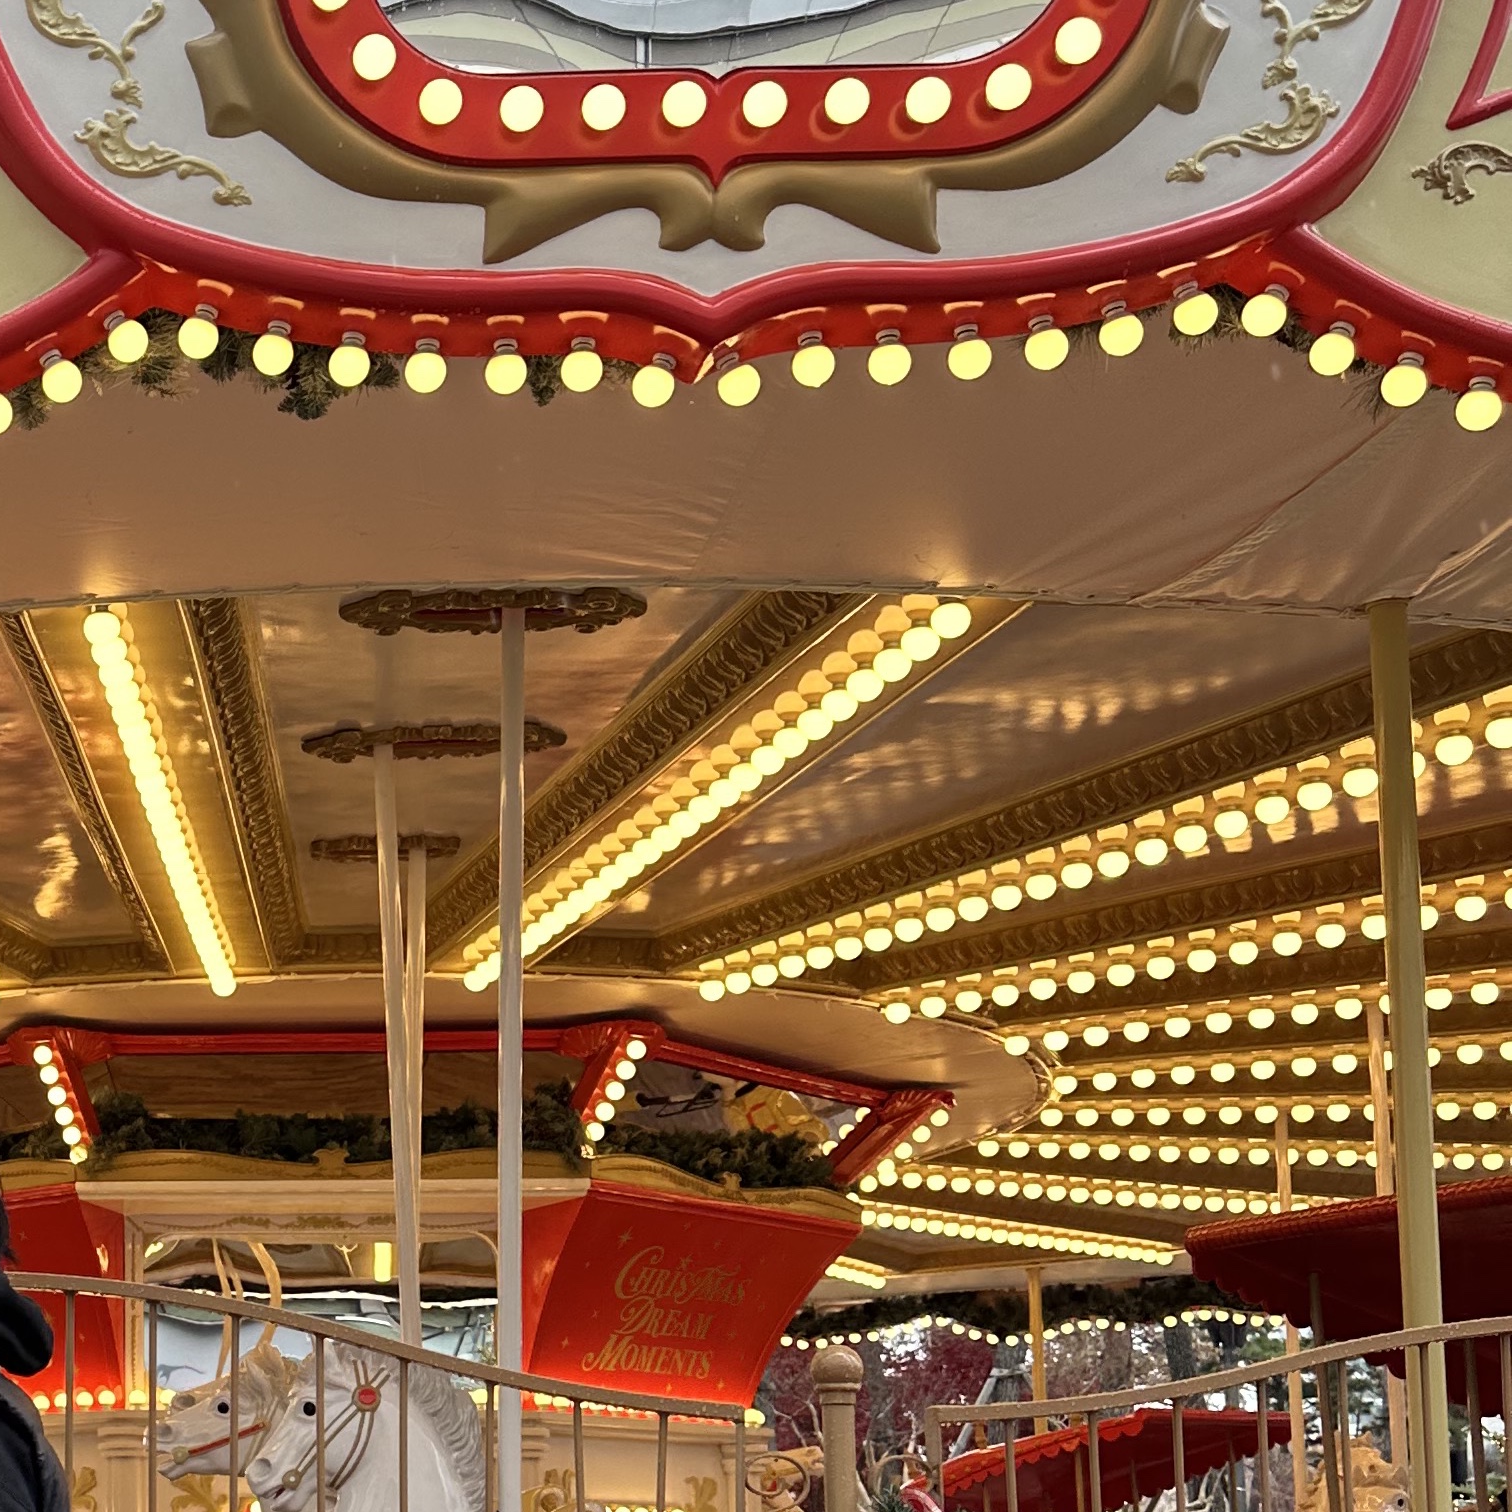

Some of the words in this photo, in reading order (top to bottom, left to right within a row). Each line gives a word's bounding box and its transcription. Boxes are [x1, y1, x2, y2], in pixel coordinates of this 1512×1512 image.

[615, 1246, 750, 1306] CHRISTMAS
[614, 1296, 713, 1340] DREAM
[582, 1334, 713, 1379] MOMENTS
